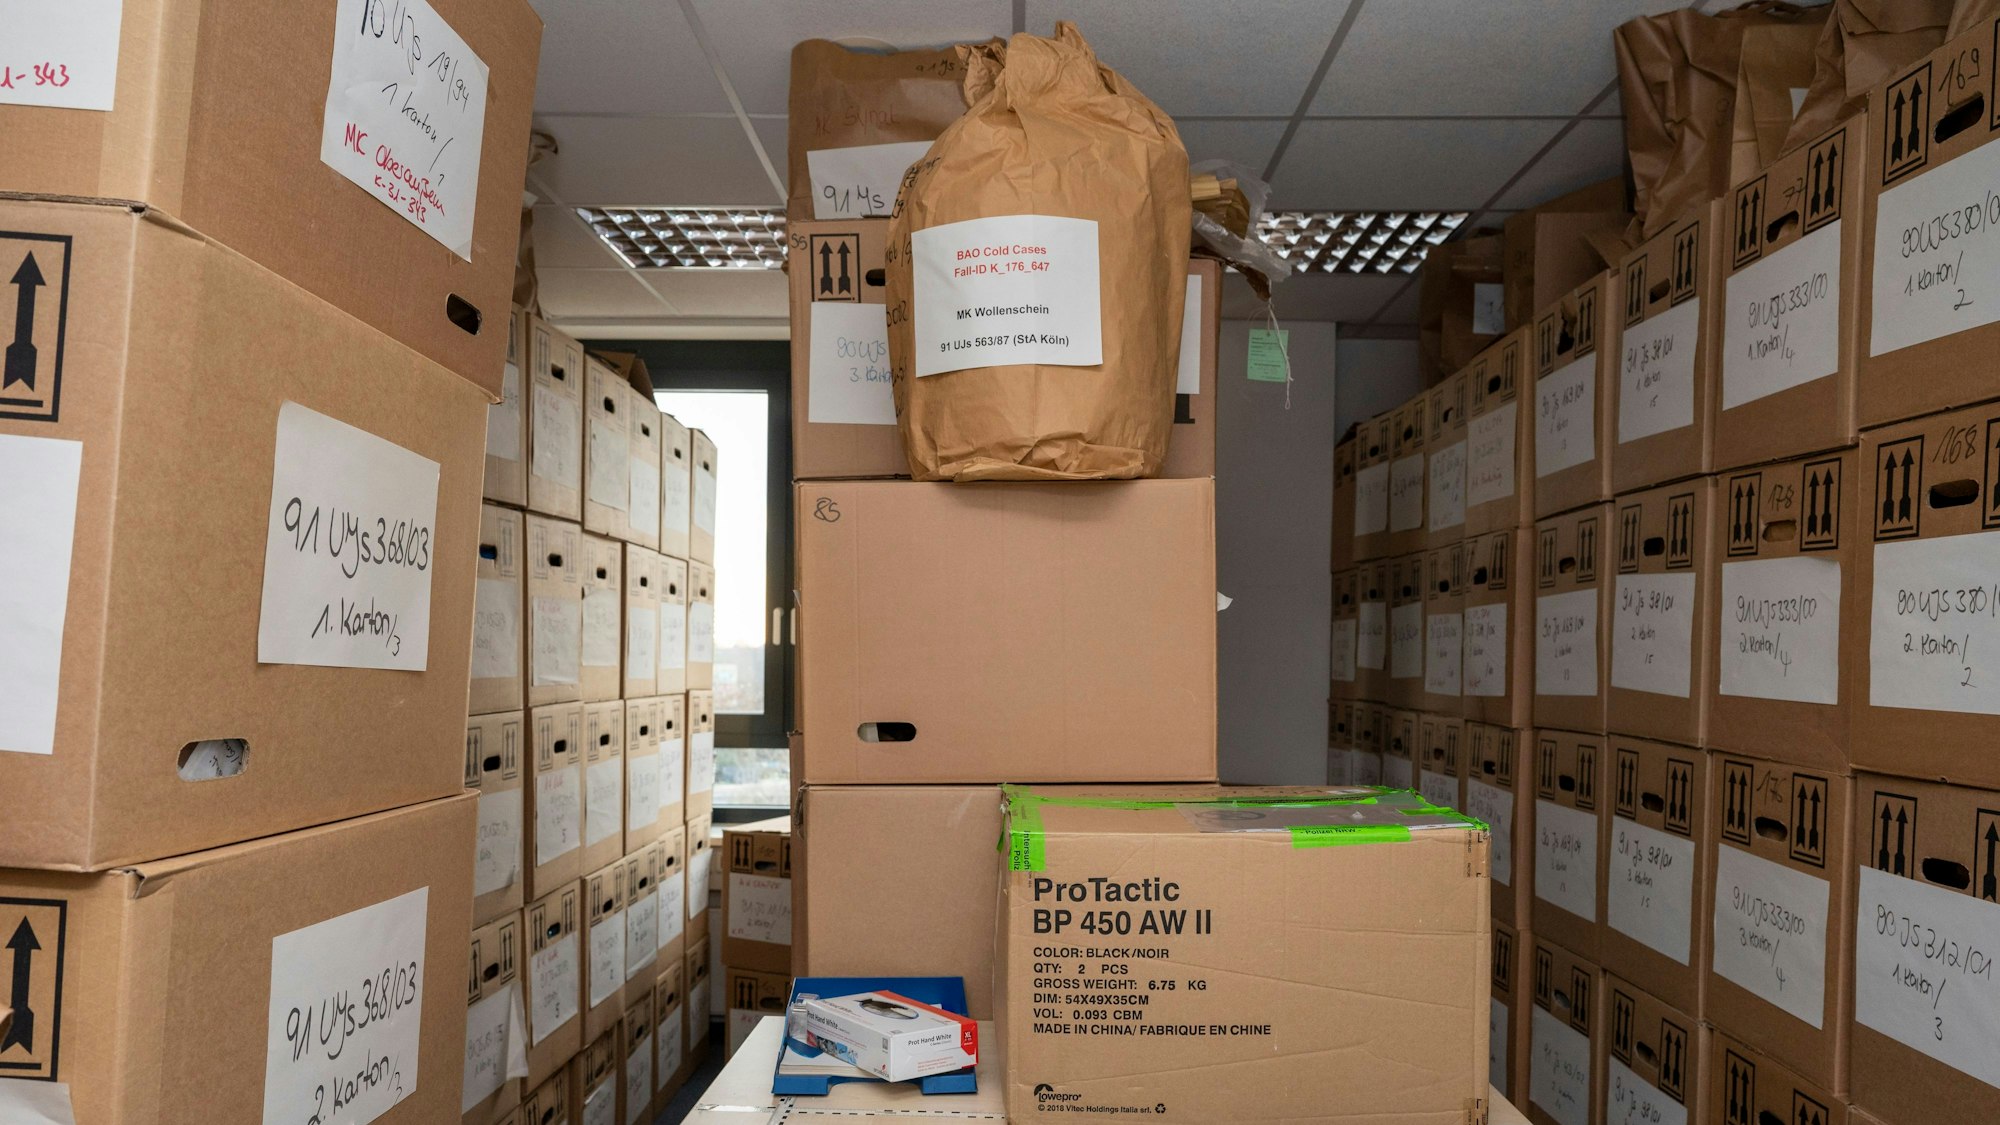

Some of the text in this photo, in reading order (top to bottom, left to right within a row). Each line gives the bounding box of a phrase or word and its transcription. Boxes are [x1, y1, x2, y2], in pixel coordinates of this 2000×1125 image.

[1938, 48, 1980, 106] 169
[345, 122, 368, 155] MK
[823, 185, 849, 213] 91
[957, 244, 1047, 261] BAO Cold Cases
[954, 261, 1050, 278] Fall-ID K_176_647
[1953, 288, 1974, 311] 2
[956, 304, 1049, 321] MK Wollenschein
[940, 334, 1070, 353] 91 UJs 563/87 (StA Köln)
[813, 497, 841, 523] 85
[284, 497, 319, 554] 91
[1961, 667, 1978, 688] 2
[1034, 877, 1180, 902] ProTactic
[1034, 910, 1211, 935] BP 450 AW II
[1034, 947, 1083, 958] COLOR:
[1034, 963, 1128, 975] QTY: 2 PCS
[1034, 979, 1206, 991] GROSS WEIGHT: 6.75 KG
[1034, 994, 1149, 1005] DIM: 54X49X35CM
[815, 1014, 826, 1024] Hand
[826, 1018, 838, 1030] White
[1034, 1009, 1143, 1020] VOL: 0.093 CBM
[286, 1006, 312, 1063] 91
[935, 1033, 952, 1041] White
[1034, 1024, 1271, 1036] MADE IN CHINA/ FABRIQUE EN CHINE
[1934, 1017, 1943, 1041] 3
[1086, 1105, 1119, 1114] Holdings
